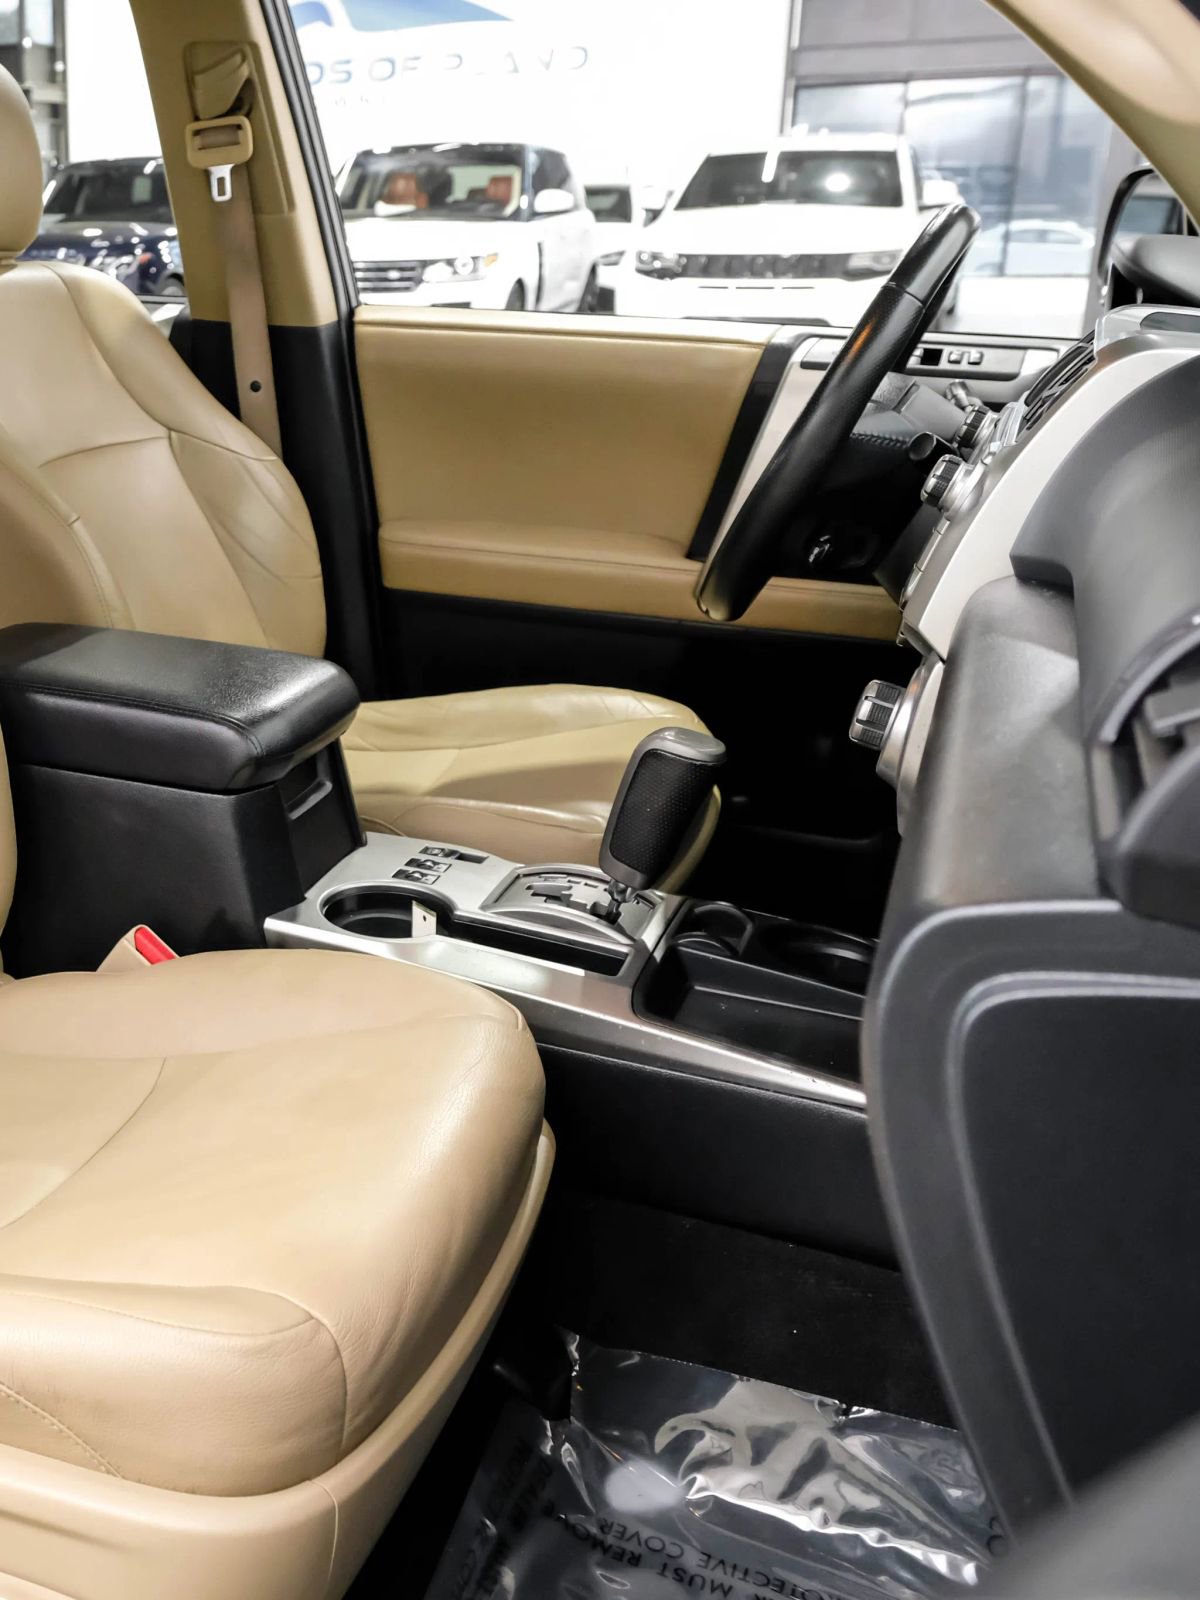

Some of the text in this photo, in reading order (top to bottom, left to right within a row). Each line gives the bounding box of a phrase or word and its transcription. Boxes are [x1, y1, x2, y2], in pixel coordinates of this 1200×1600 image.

[367, 56, 423, 82] OF
[598, 1517, 685, 1560] COVER
[656, 1562, 733, 1598] MUST
